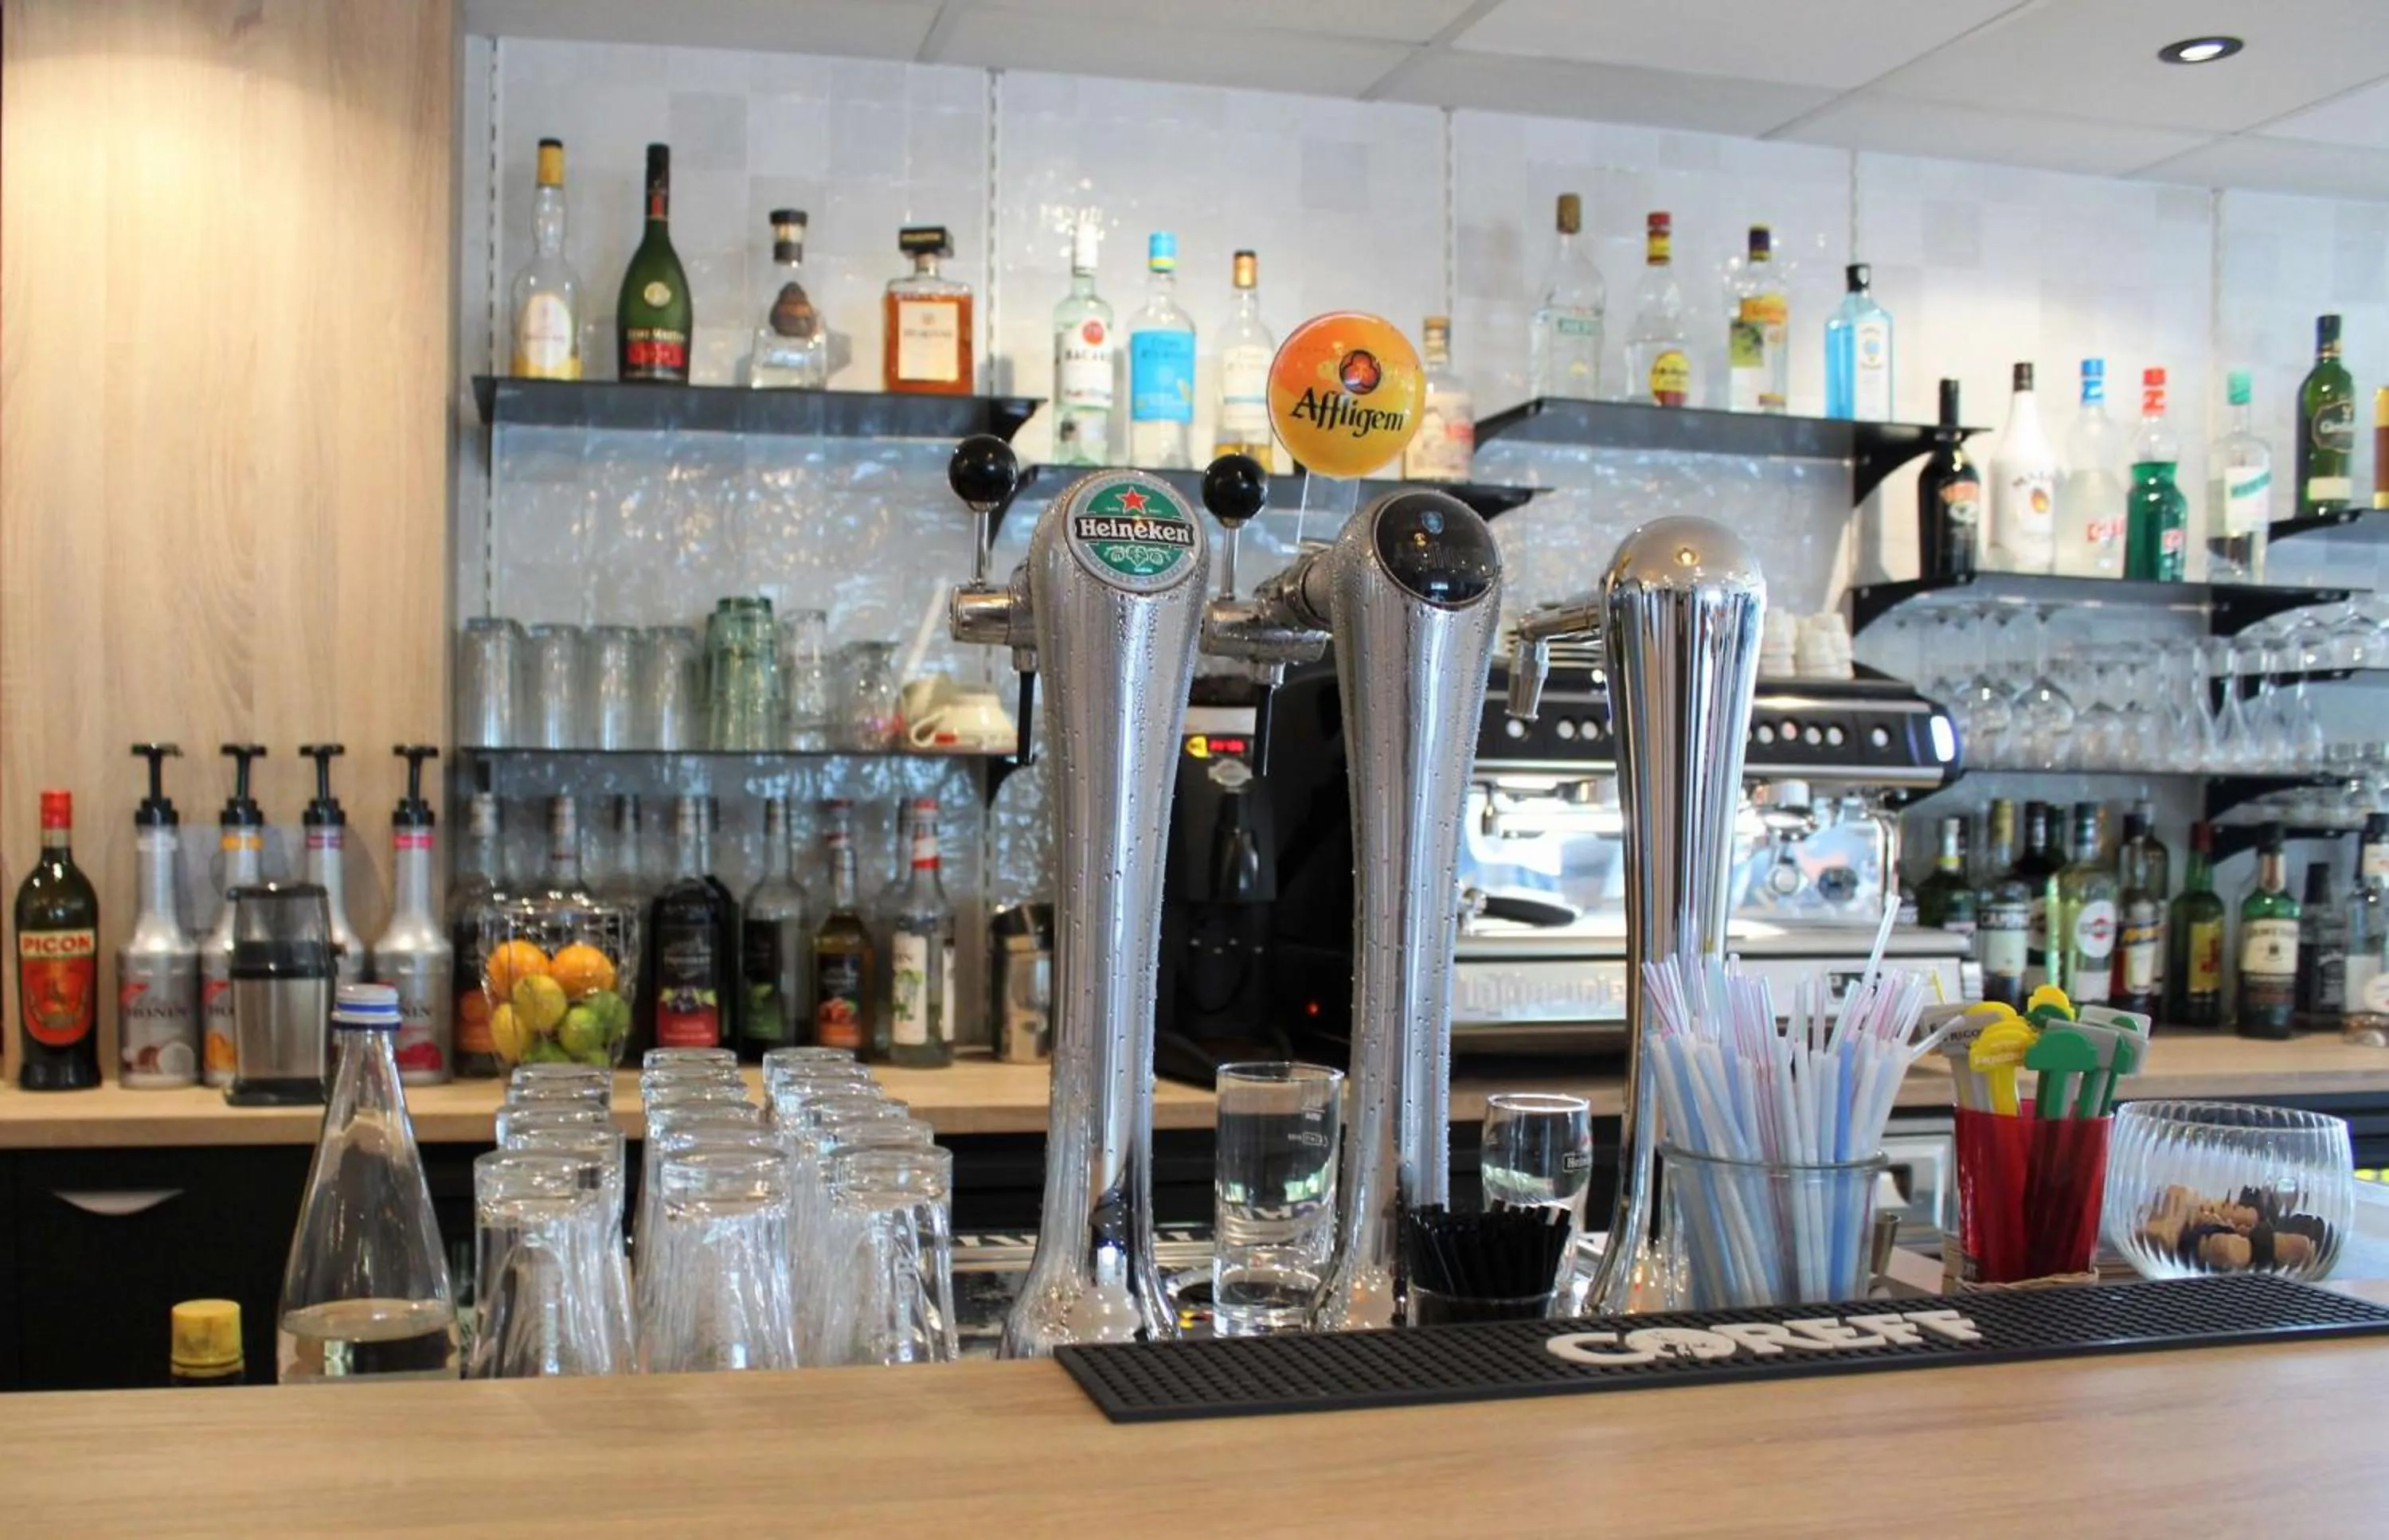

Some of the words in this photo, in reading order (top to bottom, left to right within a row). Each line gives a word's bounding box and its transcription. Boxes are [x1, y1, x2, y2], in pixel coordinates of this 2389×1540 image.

[1288, 387, 1404, 438] Affligem
[1079, 518, 1191, 544] Heineken
[22, 936, 92, 954] PICON
[1546, 1310, 1983, 1365] COREFF
